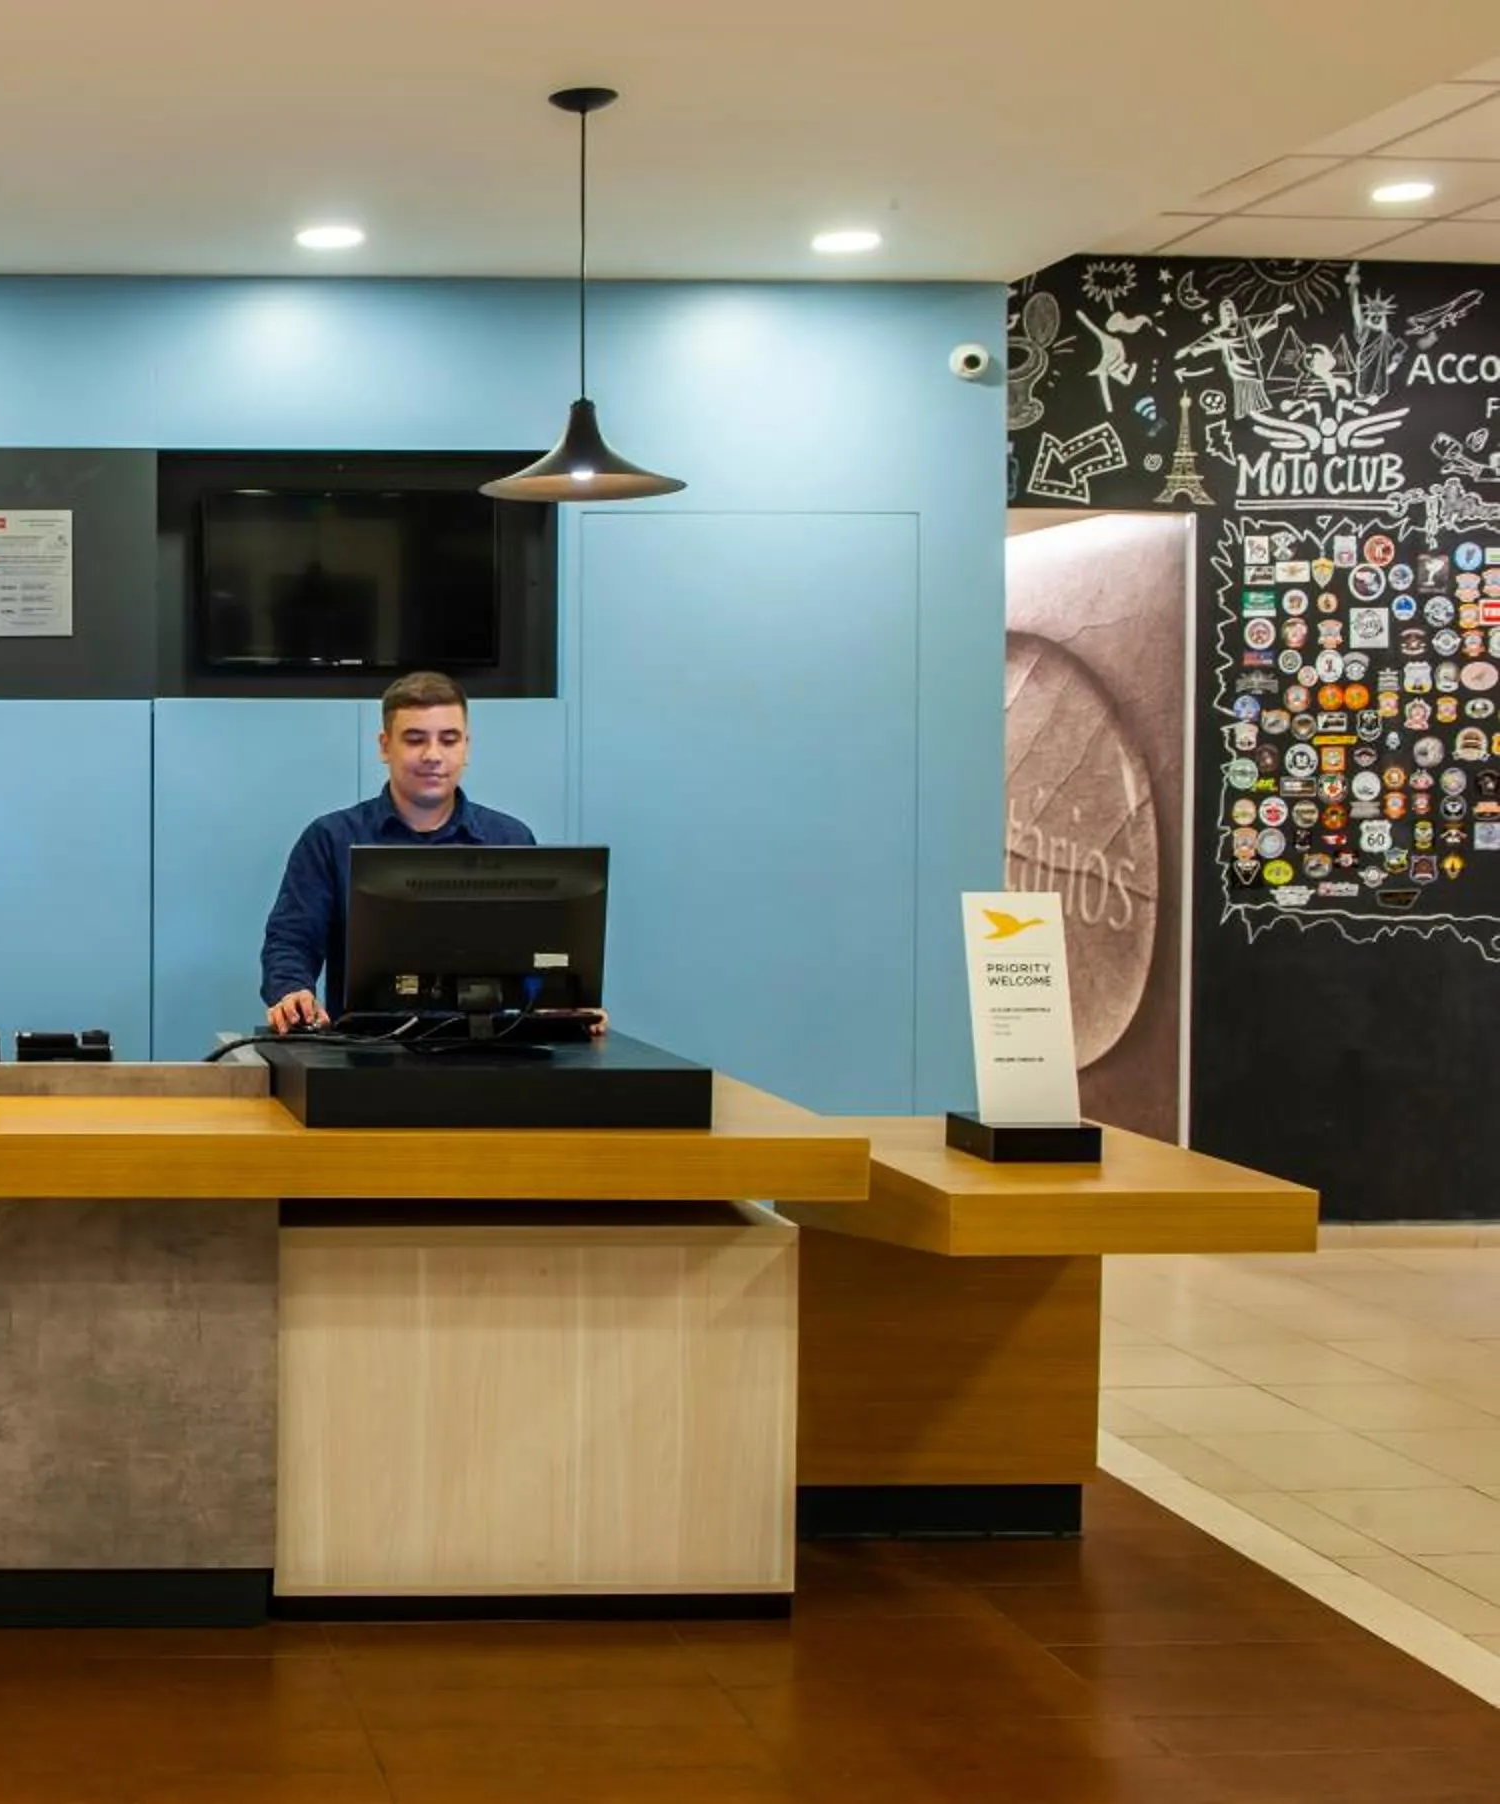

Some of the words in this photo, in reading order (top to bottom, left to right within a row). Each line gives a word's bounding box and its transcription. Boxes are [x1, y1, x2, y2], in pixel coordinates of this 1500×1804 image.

[1323, 452, 1406, 495] CLUB
[987, 962, 1051, 974] PRIORITY
[987, 975, 1052, 987] WELCOME
